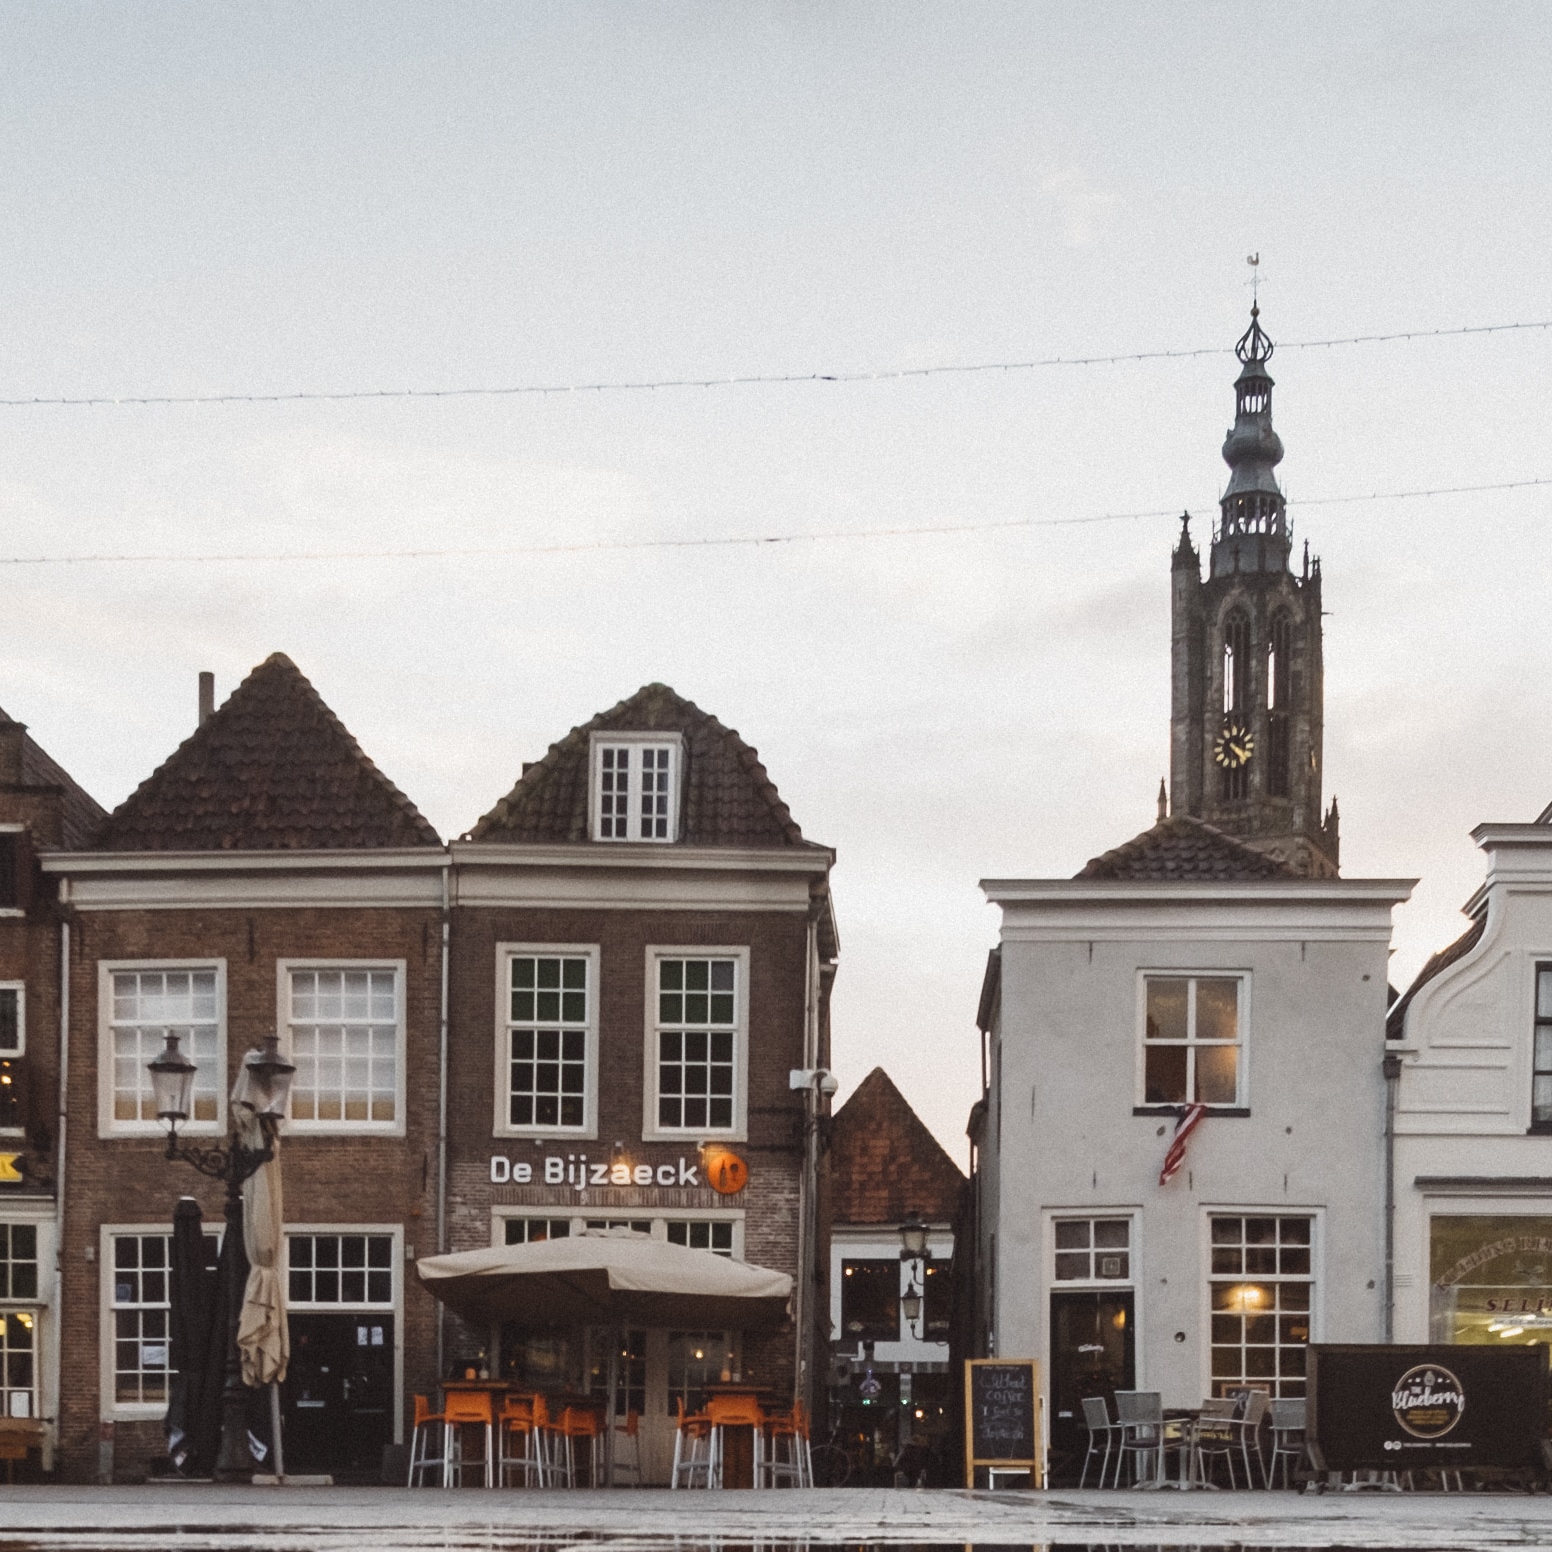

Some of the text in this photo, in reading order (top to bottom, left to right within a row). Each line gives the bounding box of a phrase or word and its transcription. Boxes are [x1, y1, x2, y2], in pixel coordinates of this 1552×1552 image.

[490, 1154, 699, 1191] De Bijzaeck
[1392, 1387, 1465, 1412] Blueberry
